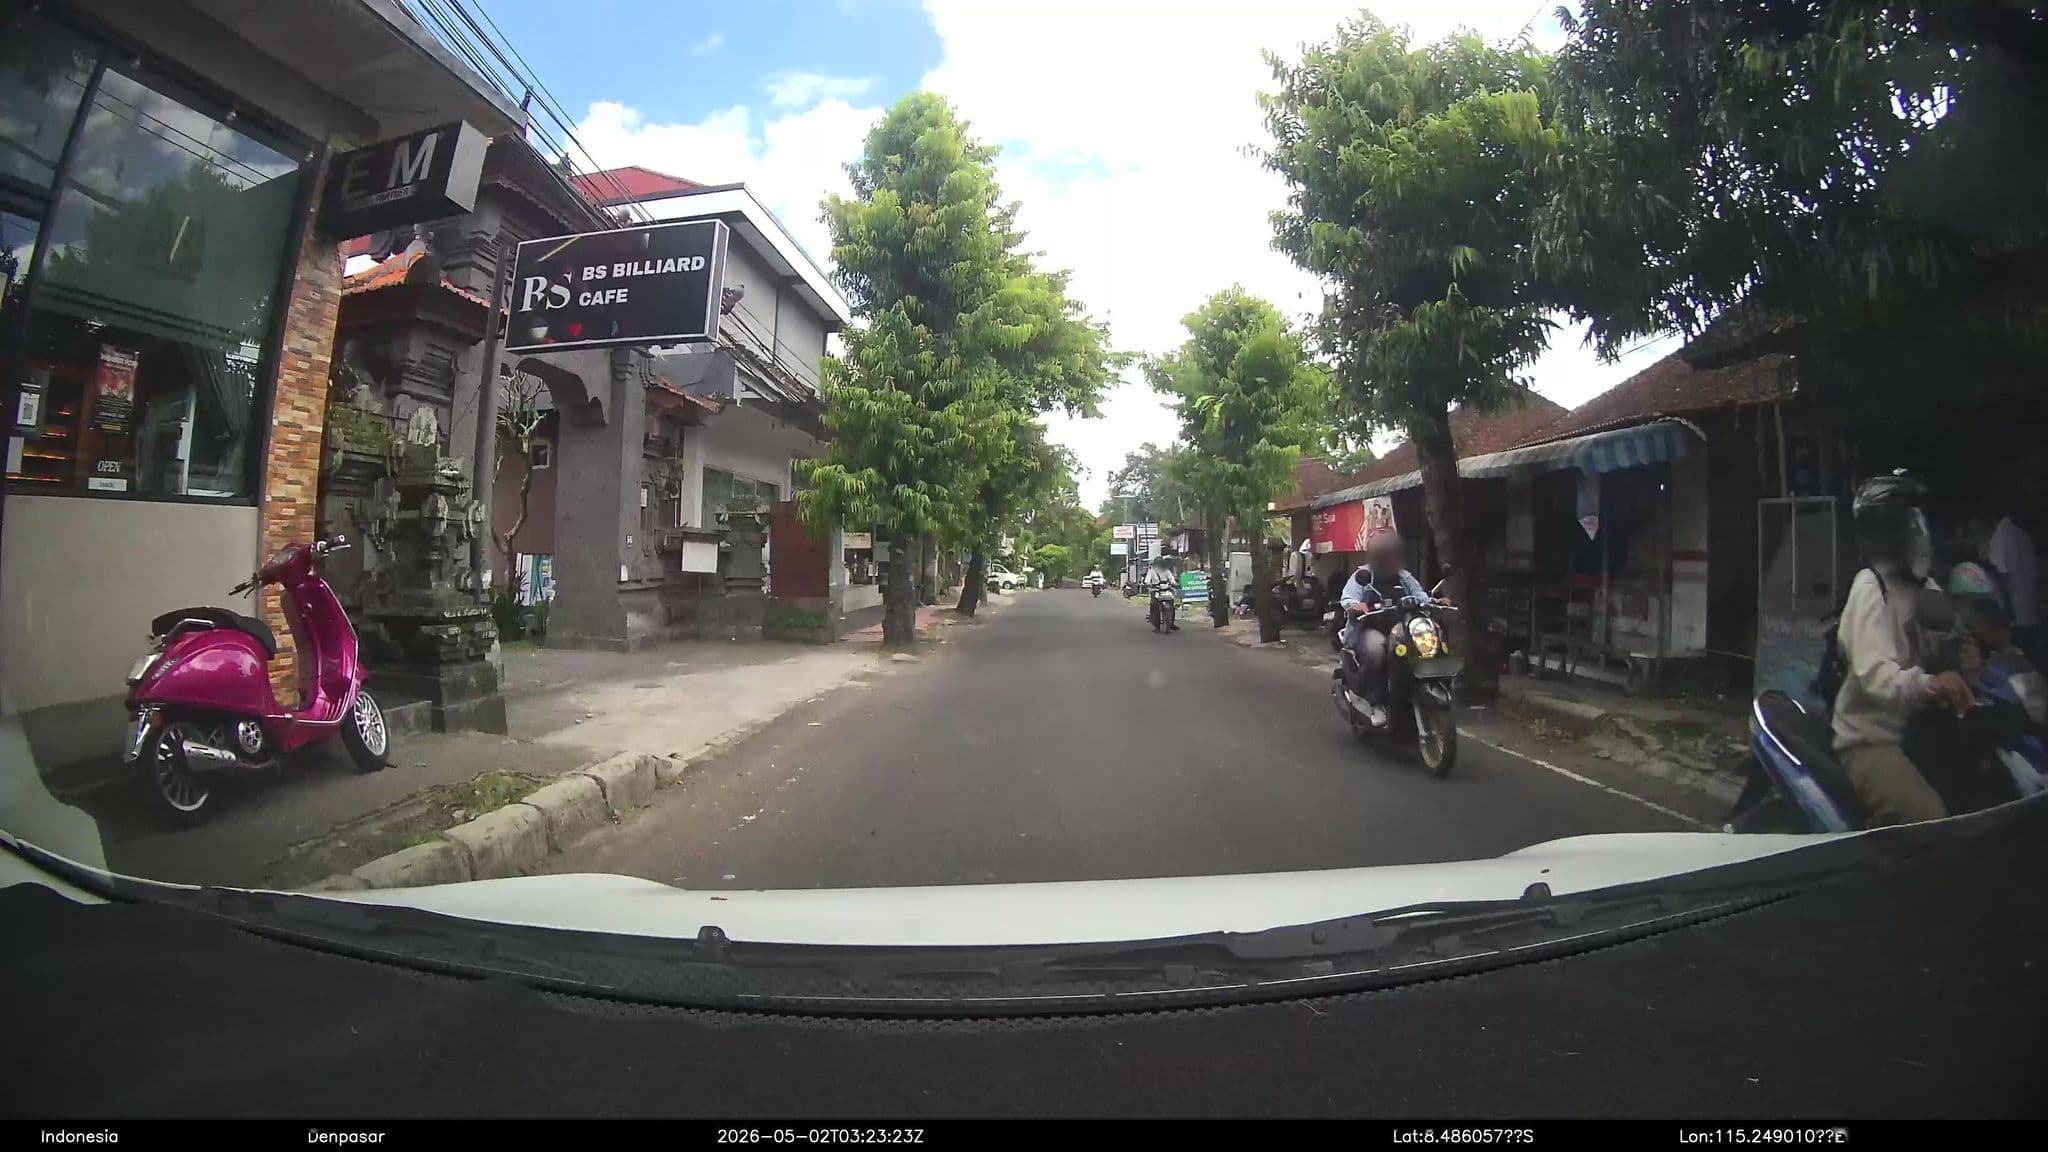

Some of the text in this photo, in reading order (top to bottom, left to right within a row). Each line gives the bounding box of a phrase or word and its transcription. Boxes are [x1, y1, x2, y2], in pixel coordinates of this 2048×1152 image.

[582, 256, 705, 281] BS BILLIARD
[578, 288, 629, 307] CAFE
[97, 460, 121, 473] OPEN
